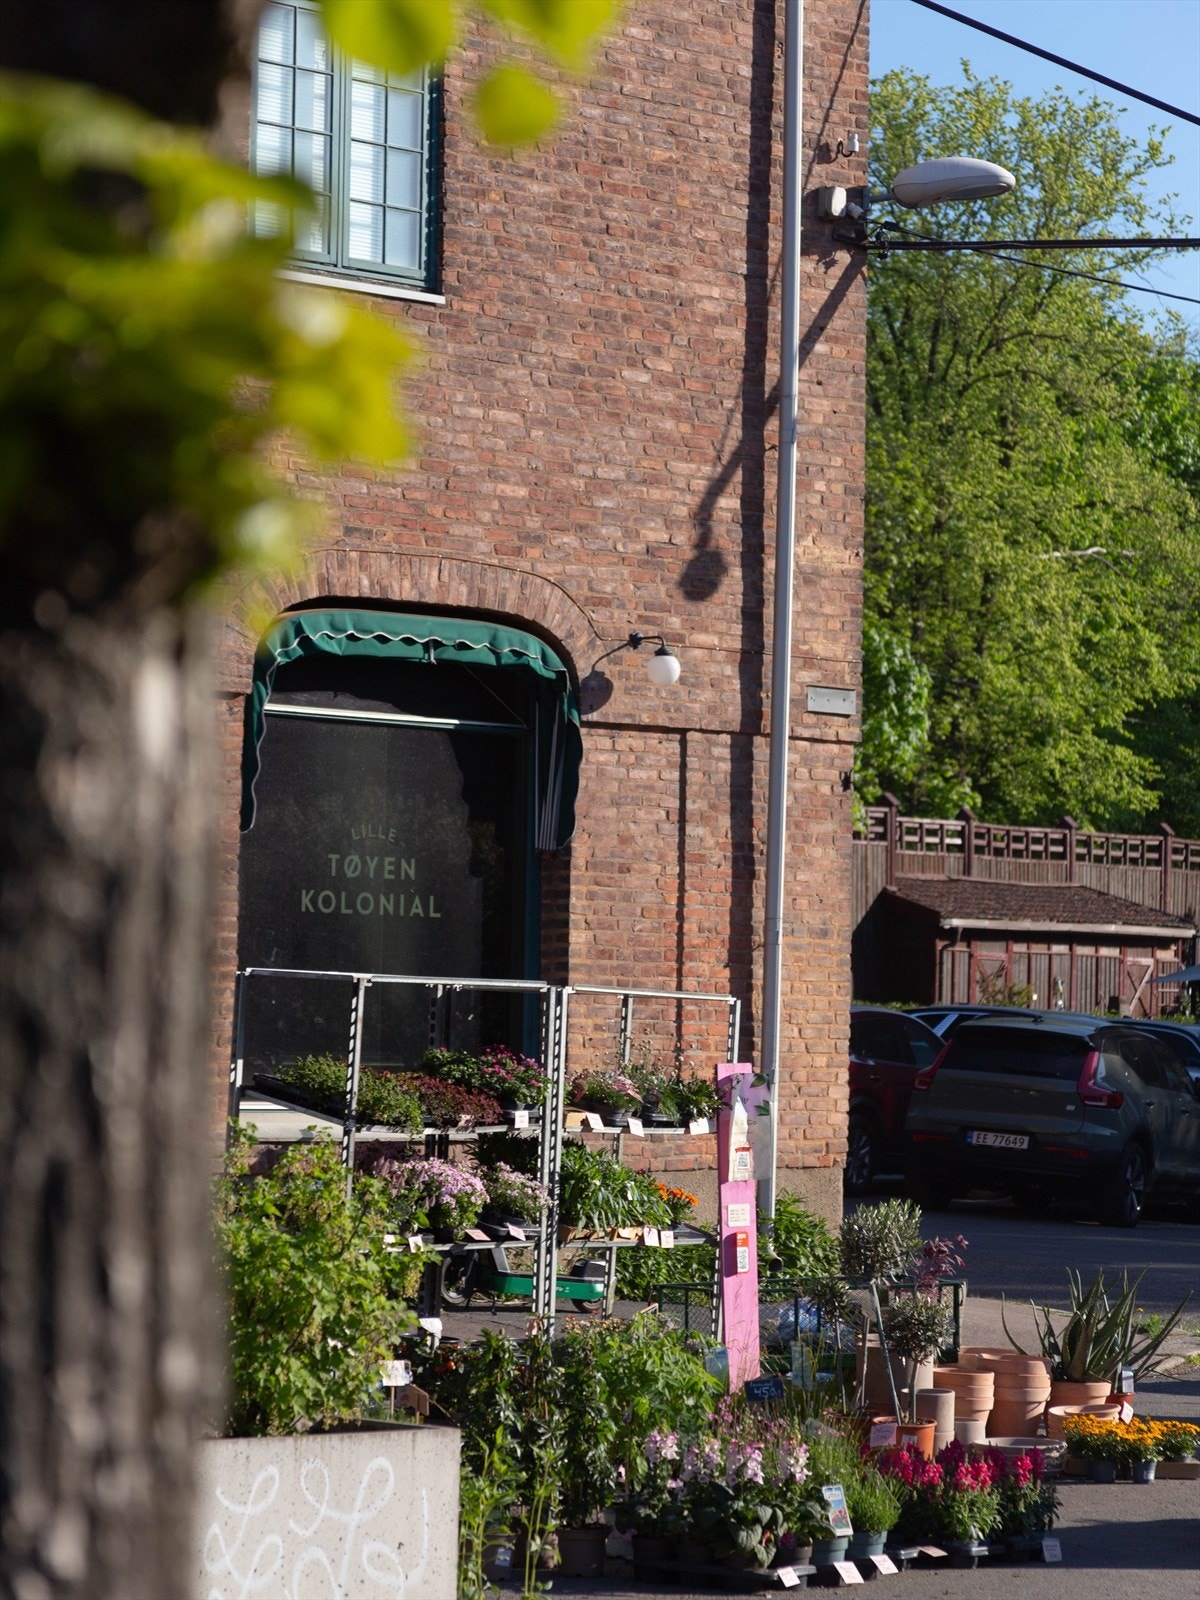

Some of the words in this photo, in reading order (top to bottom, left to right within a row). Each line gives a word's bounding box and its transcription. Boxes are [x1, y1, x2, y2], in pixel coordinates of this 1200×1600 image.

[351, 824, 397, 843] LILLE
[328, 854, 416, 880] TØYEN
[300, 889, 441, 918] KOLONIAL
[975, 1133, 988, 1144] EE
[992, 1134, 1025, 1147] 77649
